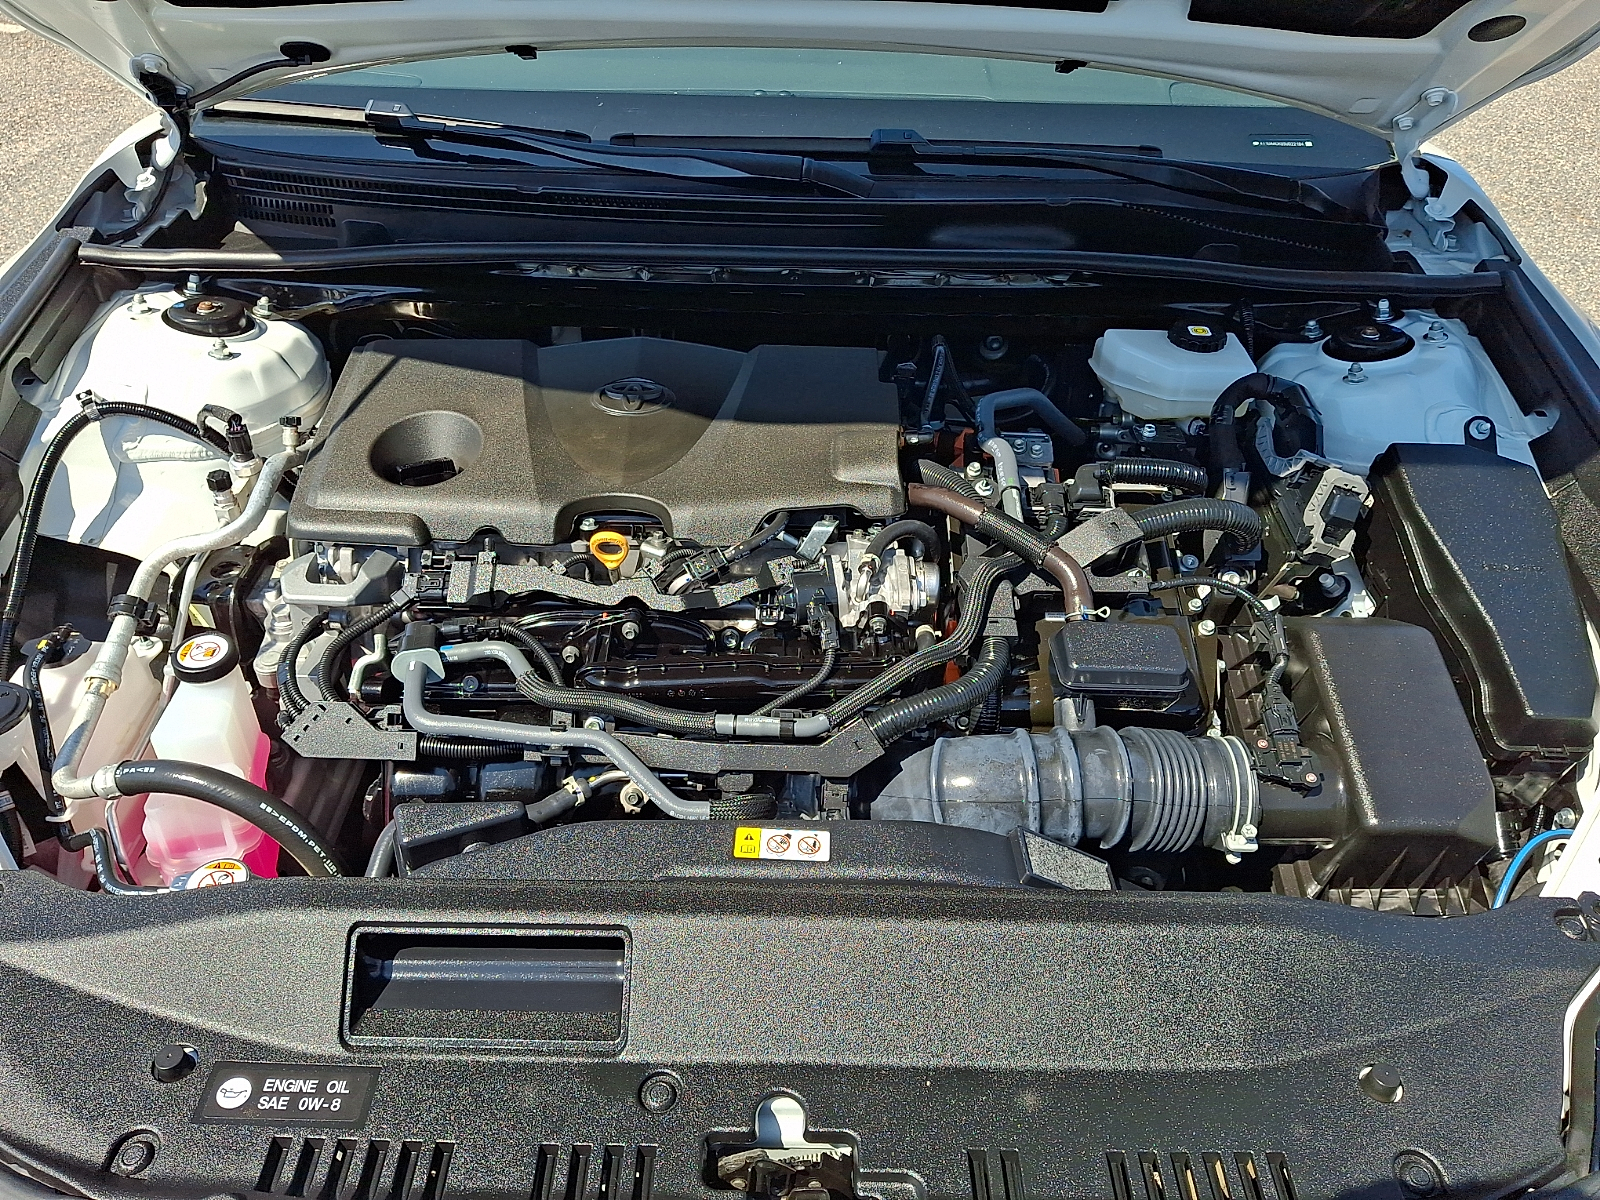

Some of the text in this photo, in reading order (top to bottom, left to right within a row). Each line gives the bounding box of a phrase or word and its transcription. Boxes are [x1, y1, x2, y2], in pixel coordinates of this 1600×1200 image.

[263, 1078, 350, 1094] ENGINE OIL
[257, 1096, 341, 1111] SAE 0W-8
